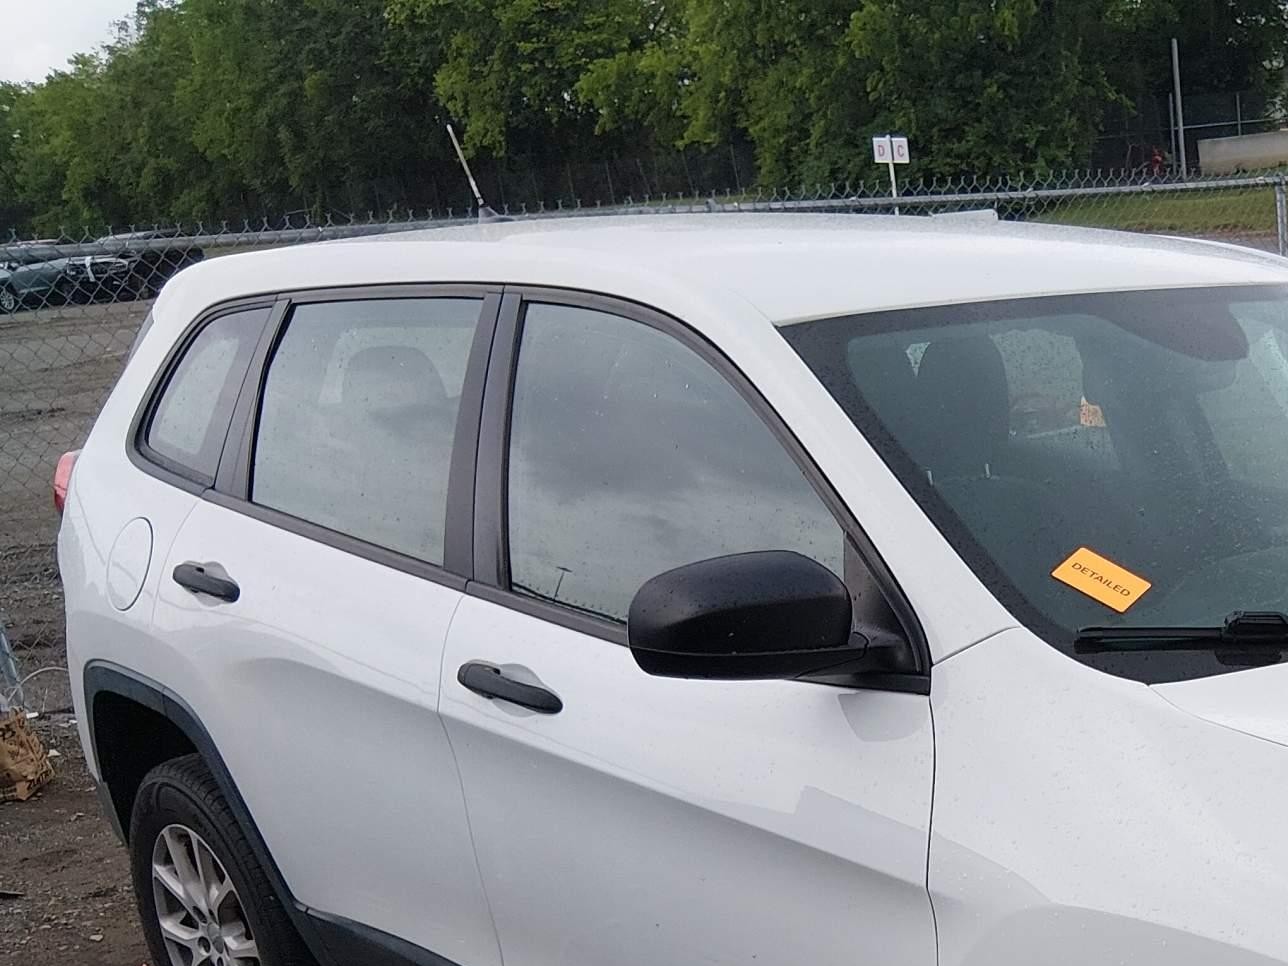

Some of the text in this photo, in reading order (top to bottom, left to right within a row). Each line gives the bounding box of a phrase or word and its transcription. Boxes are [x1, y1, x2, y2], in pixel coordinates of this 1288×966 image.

[877, 144, 886, 157] D
[896, 144, 905, 158] C
[1071, 562, 1131, 597] DETAILED
